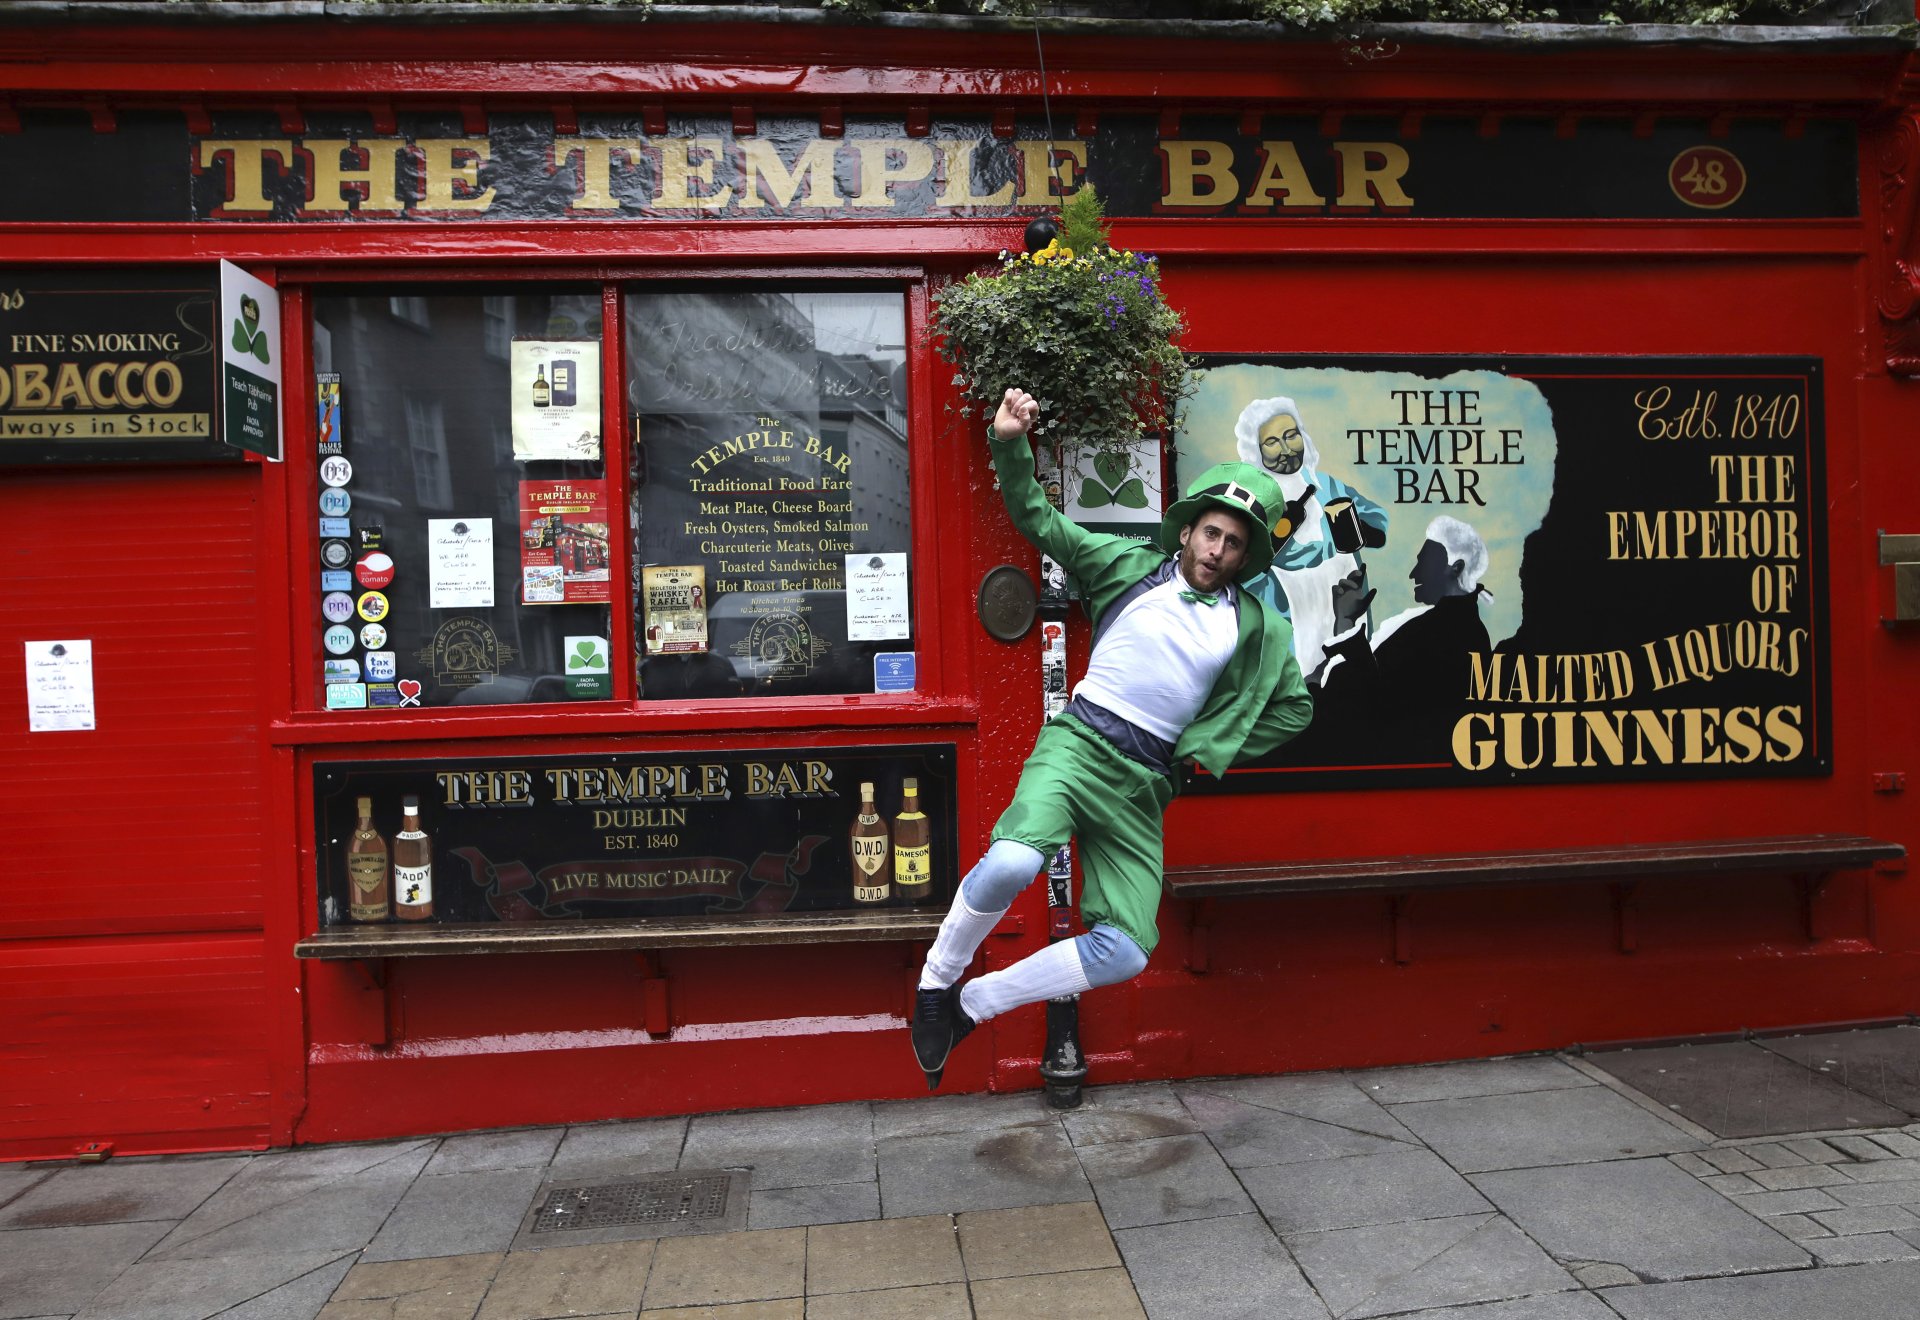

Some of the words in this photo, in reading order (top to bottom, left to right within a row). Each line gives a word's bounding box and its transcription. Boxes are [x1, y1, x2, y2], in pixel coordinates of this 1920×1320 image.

[200, 138, 497, 212] THE
[553, 137, 1093, 209] TEMPLE
[1159, 140, 1414, 208] BAR
[1680, 156, 1728, 195] 48
[11, 334, 66, 353] FINE
[71, 332, 181, 353] SMOKING
[231, 376, 248, 393] Teach
[247, 398, 258, 411] Pub
[1391, 390, 1482, 426] THE
[92, 417, 115, 434] in
[127, 414, 205, 434] Stock
[757, 417, 780, 427] The
[1730, 393, 1801, 440] 1840
[242, 423, 264, 438] APPROVED
[690, 430, 794, 475] TEMPLE
[803, 436, 852, 475] BAR
[1346, 429, 1526, 466] TEMPLE
[753, 455, 769, 463] Est.
[772, 455, 791, 463] 1840
[689, 477, 773, 492] Traditional
[779, 477, 815, 491] Food
[821, 476, 853, 490] Fare
[1394, 468, 1487, 506] BAR
[1710, 455, 1795, 504] THE
[326, 497, 345, 507] PPI
[529, 492, 572, 501] TEMPLE
[575, 492, 597, 500] BAR
[700, 501, 730, 515] Meat
[734, 501, 768, 516] Plate,
[772, 500, 813, 513] Cheese
[817, 500, 853, 513] Board
[685, 522, 717, 535] Fresh
[721, 521, 769, 538] Oysters,
[773, 520, 820, 533] Smoked
[824, 519, 869, 533] Salmon
[1605, 508, 1801, 560] EMPEROR
[700, 540, 772, 554] Charcuterie
[776, 539, 814, 554] Meats,
[818, 538, 854, 551] Olives
[719, 560, 765, 573] Toasted
[769, 558, 838, 572] Sandwiches
[715, 580, 739, 593] Hot
[743, 579, 776, 592] Roast
[780, 578, 807, 592] Beef
[812, 577, 842, 590] Rolls
[1750, 564, 1798, 613] OF
[329, 602, 348, 612] PPI
[650, 597, 688, 605] RAFFLE
[436, 633, 447, 656] THE
[445, 620, 484, 633] TEMPLE
[482, 629, 494, 652] BAR
[752, 626, 763, 648] THE
[761, 613, 799, 626] TEMPLE
[798, 624, 808, 645] BAR
[330, 636, 349, 645] PPI
[370, 656, 389, 666] tax
[1465, 649, 1636, 704] MALTED
[1640, 619, 1810, 693] LIQUORS
[370, 667, 394, 676] free
[1451, 705, 1805, 772] GUINNESS
[436, 770, 534, 809] THE
[545, 765, 731, 805] TEMPLE
[744, 761, 840, 800] BAR
[593, 807, 687, 830] DUBLIN
[604, 835, 640, 850] EST.
[646, 833, 678, 849] 1840
[855, 840, 885, 856] D.W.D.
[895, 848, 929, 858] JAMESON
[395, 867, 431, 881] PADDY
[551, 872, 599, 893] LIVE
[606, 871, 674, 890] MUSIC
[674, 868, 736, 886] DAILY
[896, 873, 912, 881] IRISH
[860, 887, 884, 900] D.W.D.
